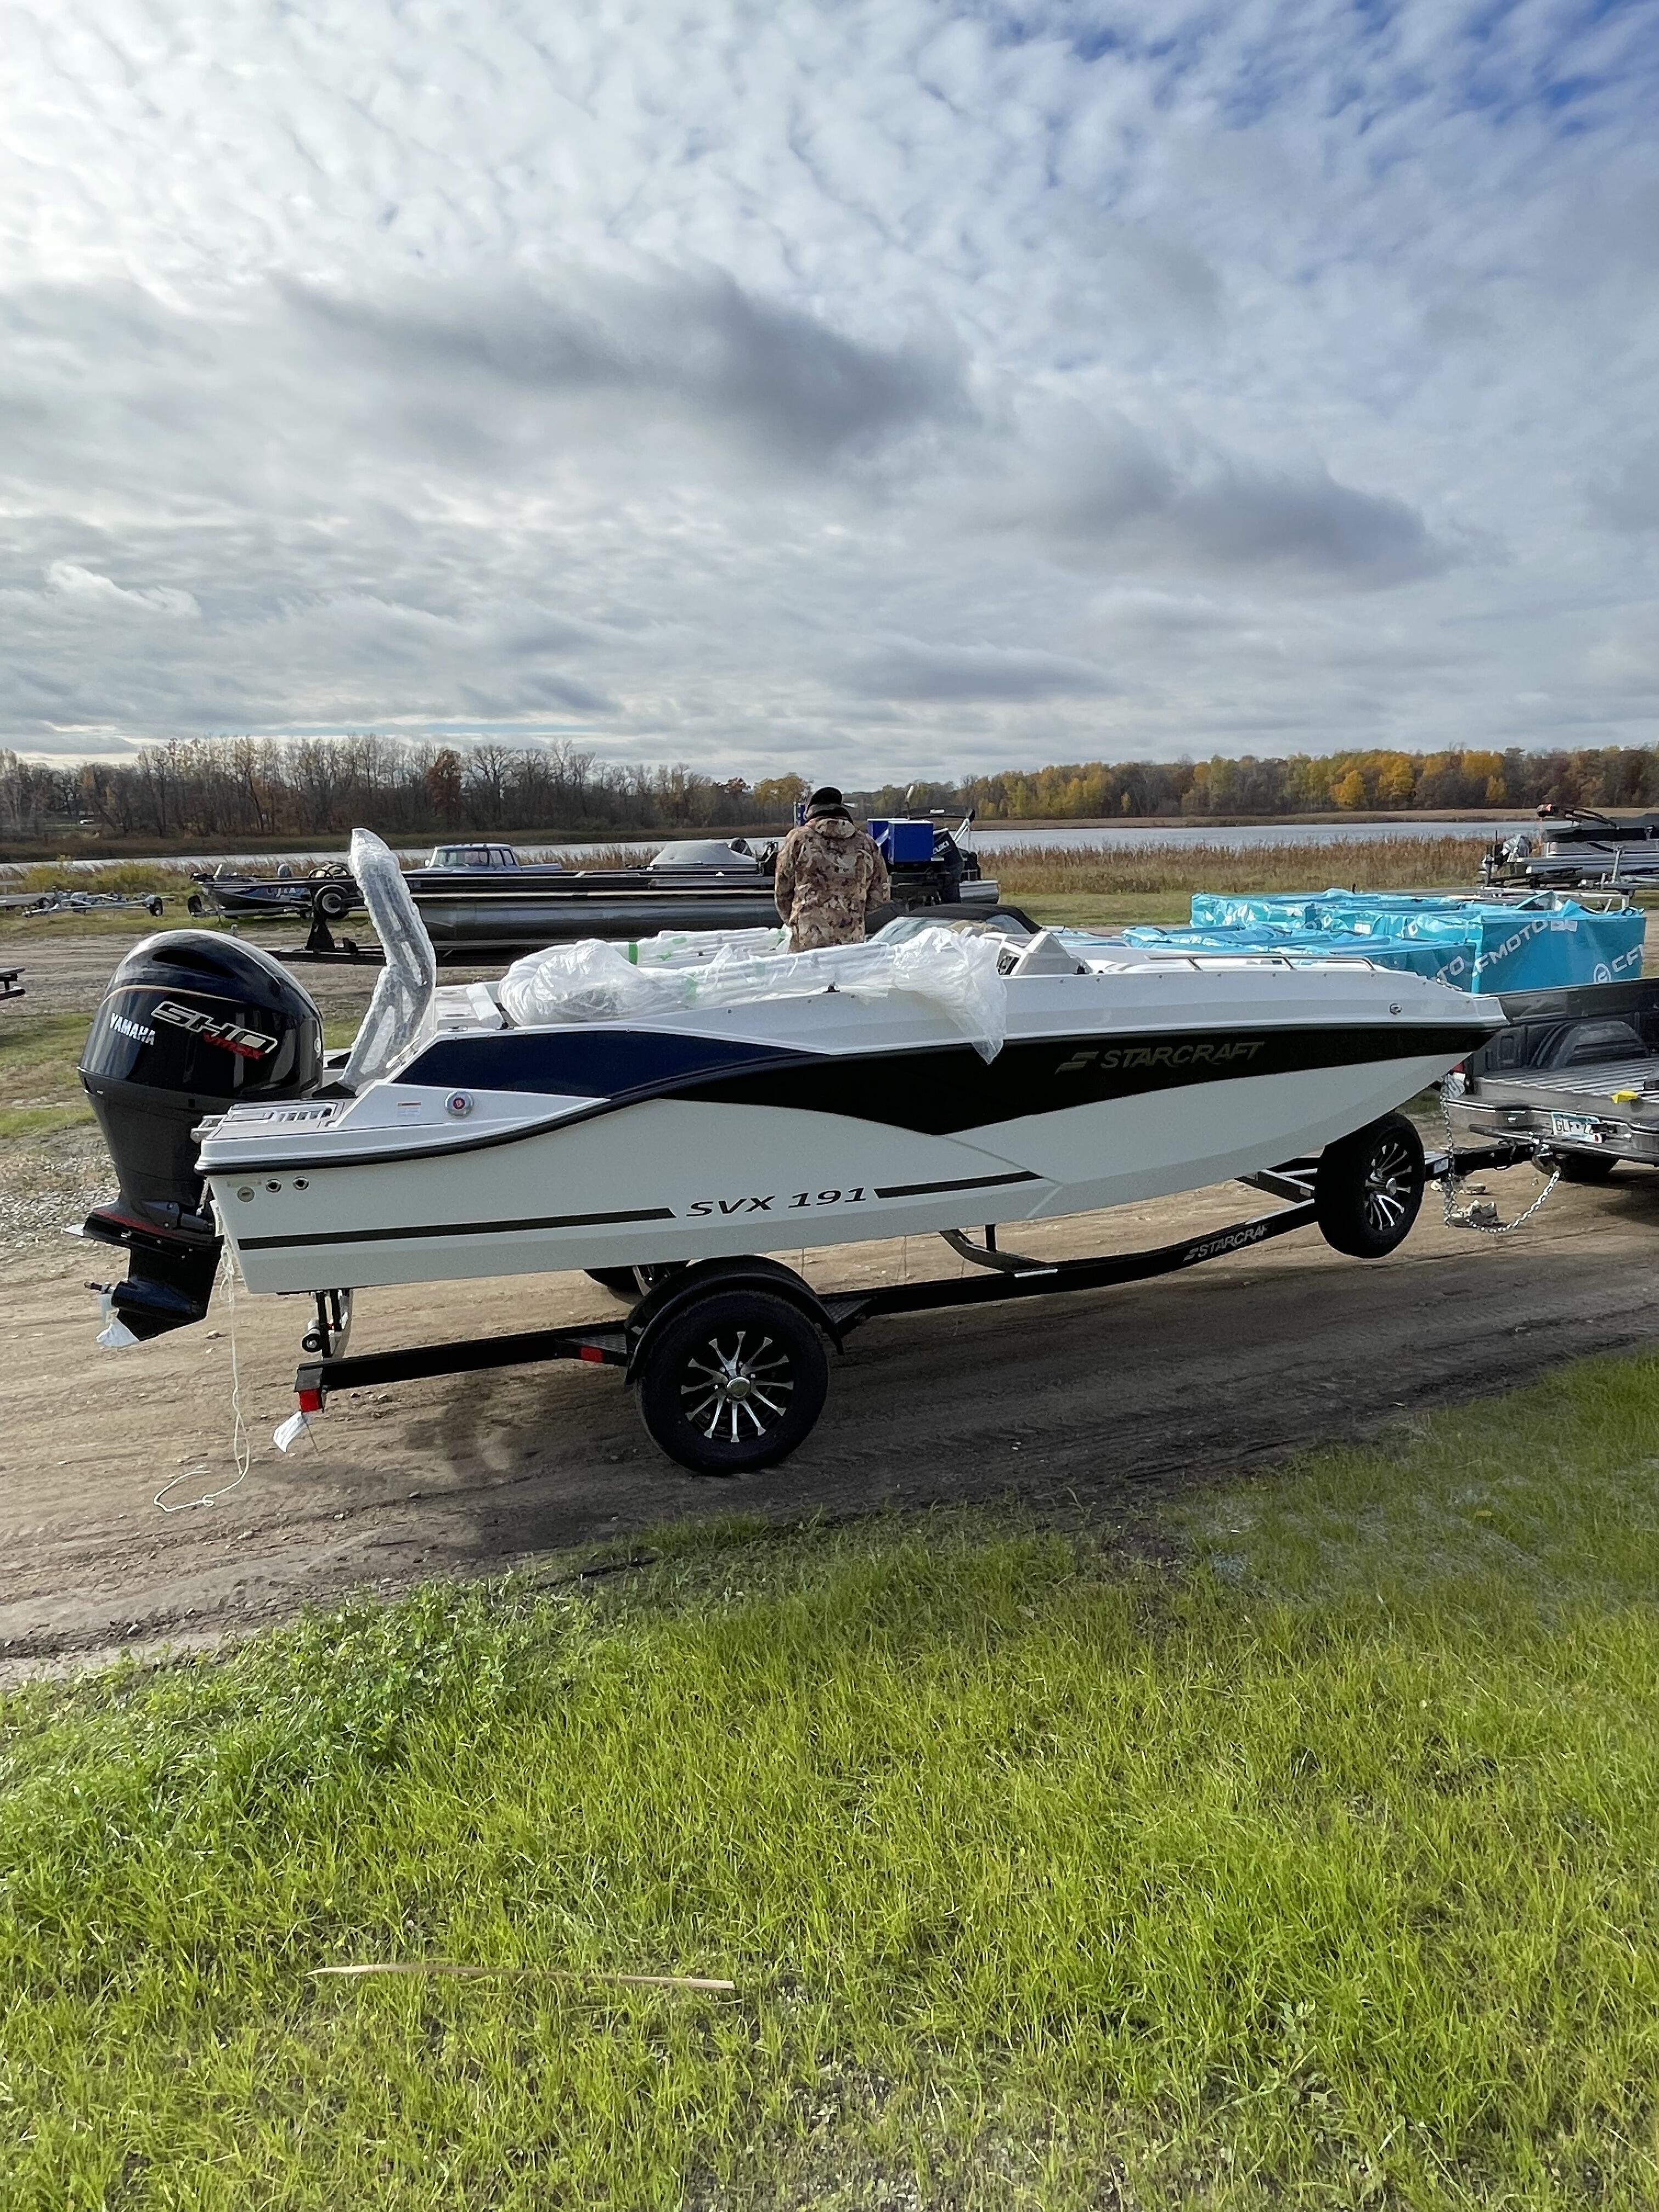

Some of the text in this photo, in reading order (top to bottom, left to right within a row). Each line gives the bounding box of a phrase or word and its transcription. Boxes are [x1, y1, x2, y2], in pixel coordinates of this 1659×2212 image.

[1472, 919, 1548, 978] FMOTO
[110, 1013, 156, 1046] YAMAHA
[150, 1001, 278, 1054] SHO
[1100, 1041, 1265, 1069] STARCRAFT
[686, 1187, 867, 1217] SVX 191
[1198, 1223, 1272, 1257] STARCRAF
